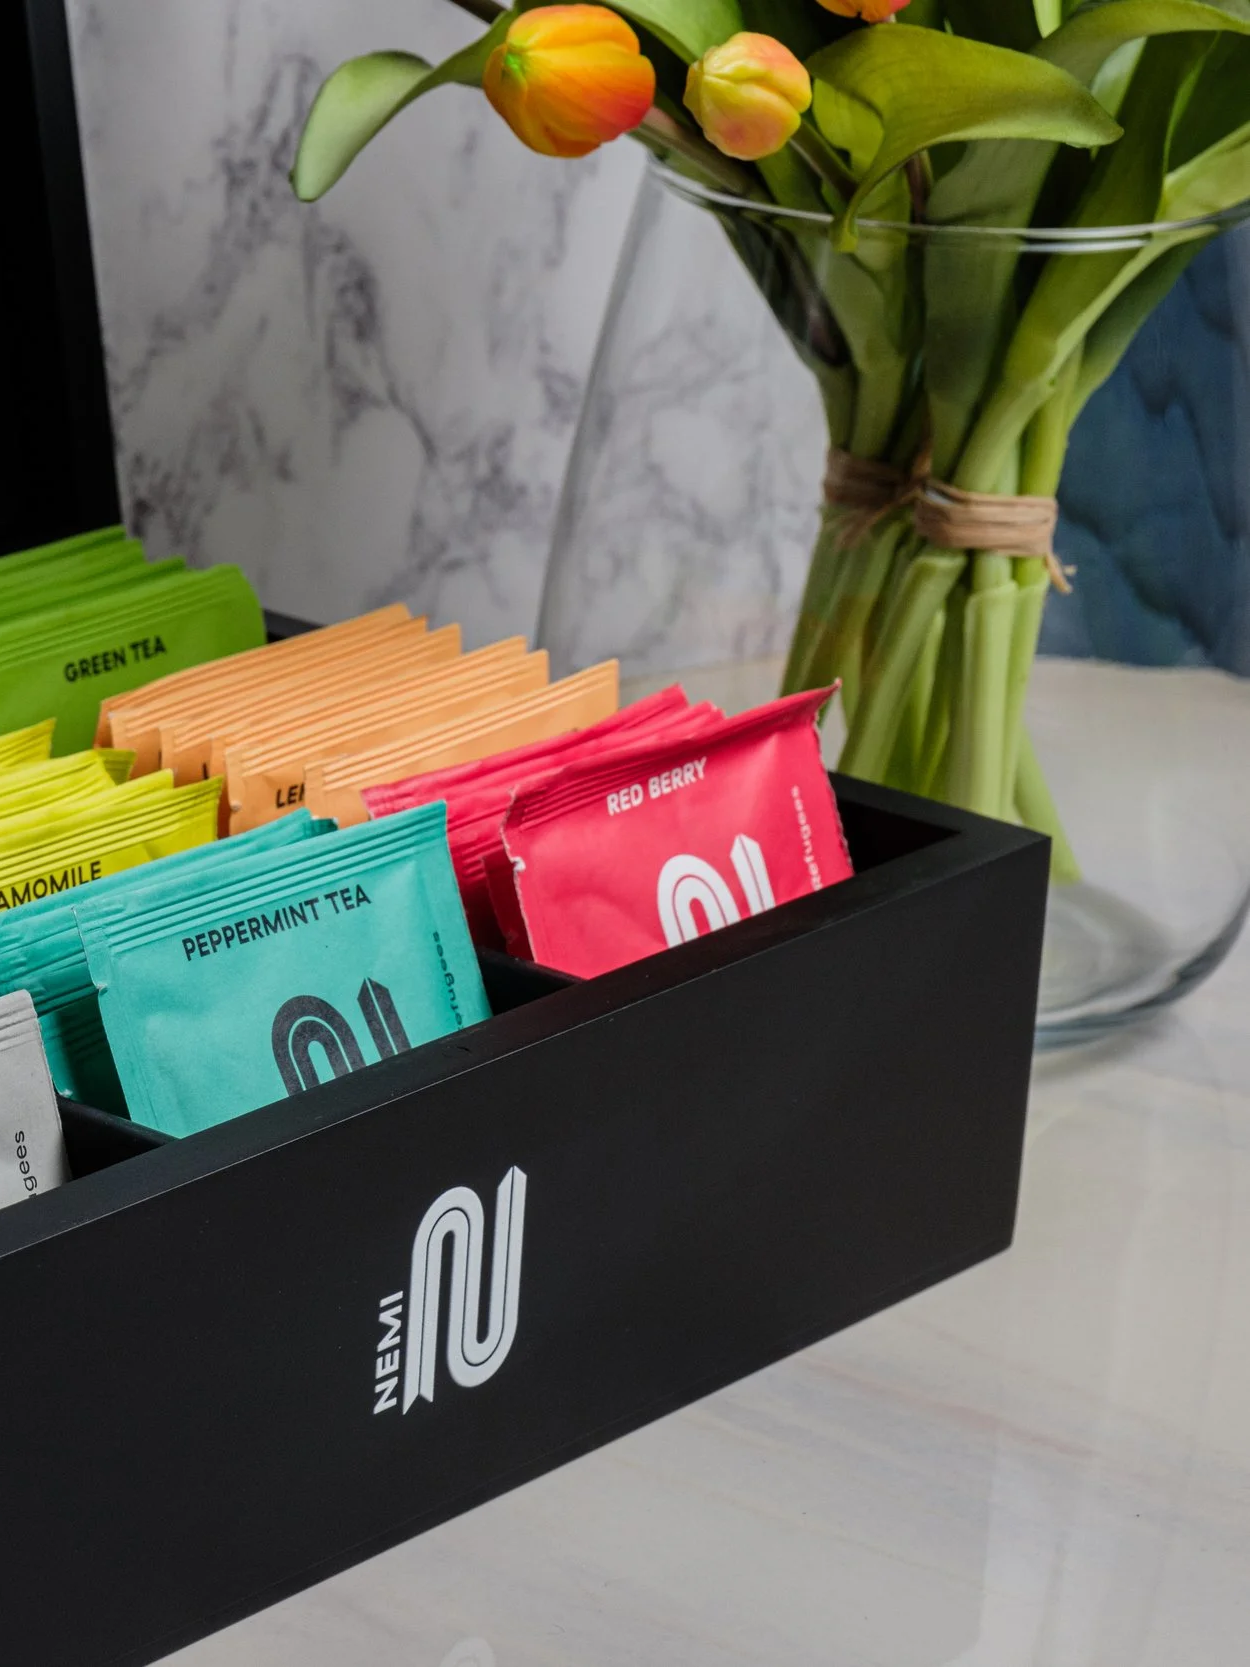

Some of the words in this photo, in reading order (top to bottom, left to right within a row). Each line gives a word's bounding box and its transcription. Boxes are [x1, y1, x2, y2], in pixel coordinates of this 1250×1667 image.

[64, 647, 127, 682] GREEN
[130, 636, 166, 662] TEA
[607, 784, 644, 816] RED
[648, 756, 707, 799] BERRY
[182, 897, 319, 961] PEPPERMINT
[324, 884, 371, 915] TEA
[15, 1130, 37, 1197] gees
[373, 1290, 403, 1414] NEMI
